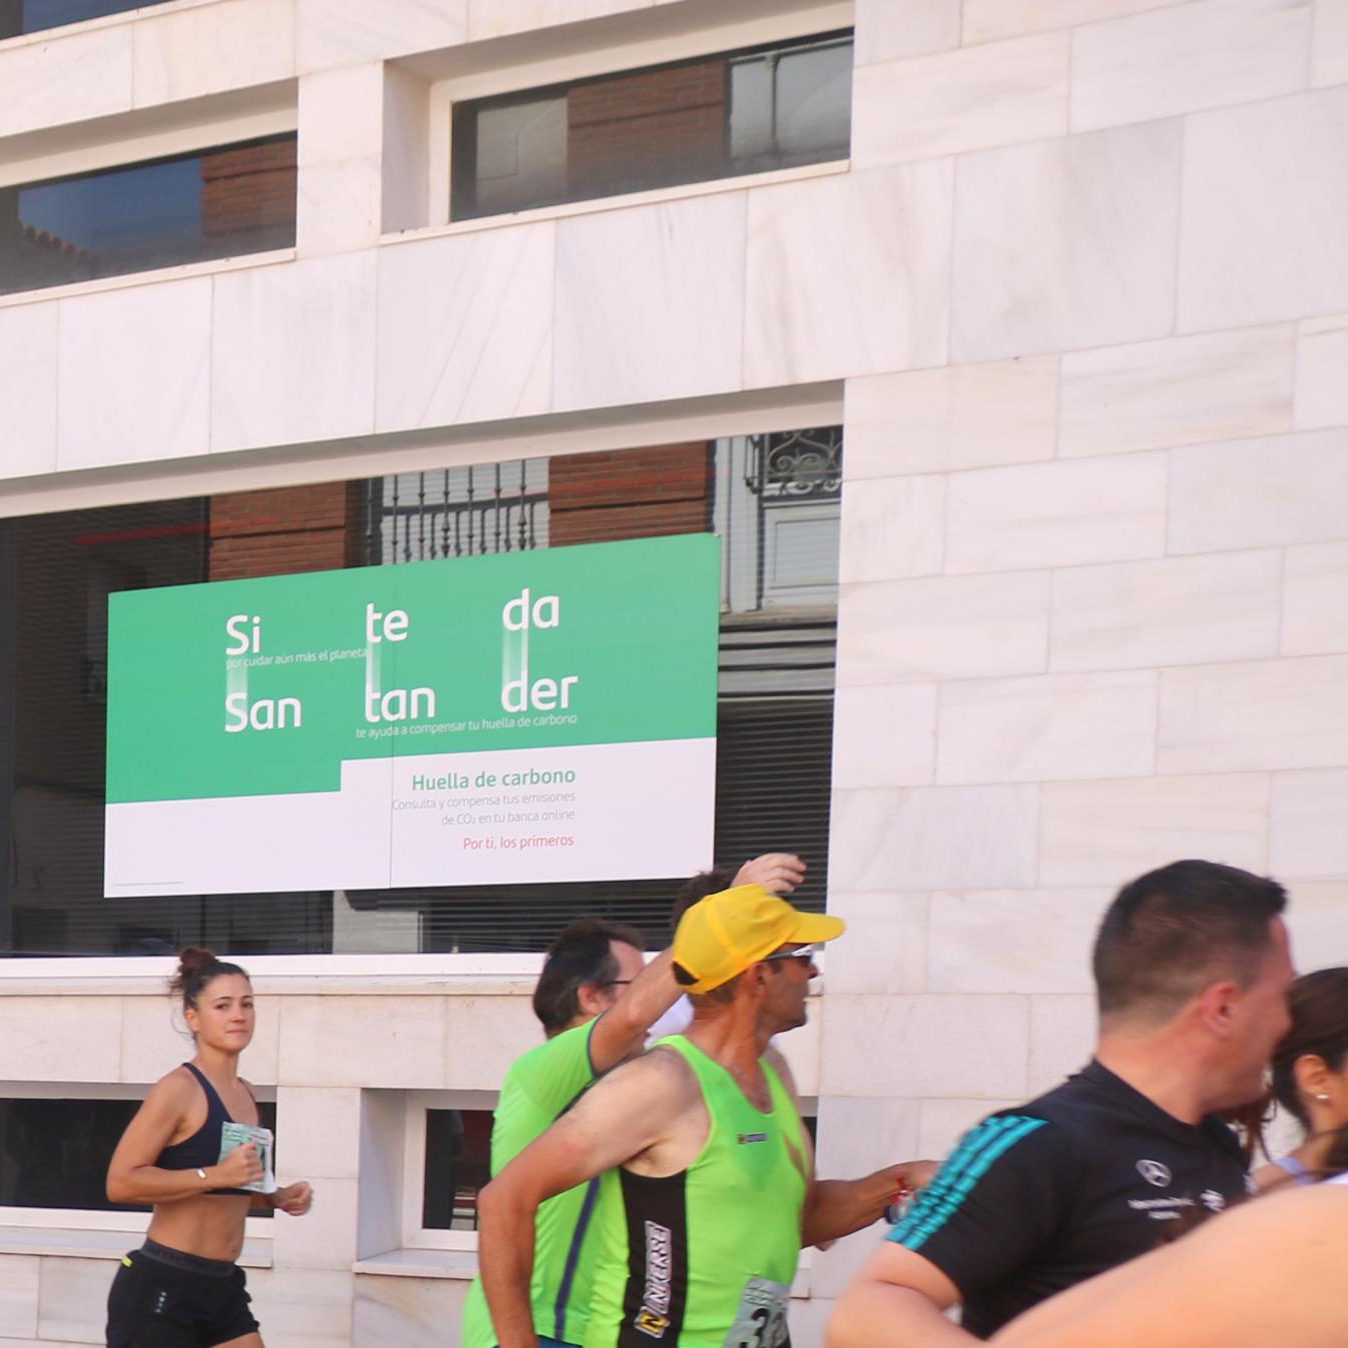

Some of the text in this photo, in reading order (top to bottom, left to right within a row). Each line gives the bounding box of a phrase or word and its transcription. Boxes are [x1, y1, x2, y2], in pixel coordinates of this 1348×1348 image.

[225, 588, 560, 655] Si te da
[244, 656, 272, 667] cuidar
[295, 651, 316, 662] más
[318, 650, 328, 661] el
[330, 648, 368, 661] planeta
[225, 671, 578, 732] San tan der
[356, 728, 366, 738] te
[368, 724, 399, 739] ayuda
[409, 720, 466, 735] compensar
[469, 720, 480, 731] tu
[481, 718, 515, 729] huella
[517, 716, 531, 727] de
[533, 714, 577, 726] carbono
[412, 768, 575, 791] Huella de carbono
[391, 798, 437, 811] Consulta
[439, 799, 446, 811] y
[447, 797, 501, 810] compensa
[441, 814, 455, 826] de
[479, 814, 492, 824] en
[494, 813, 505, 823] tu
[507, 811, 539, 823] banca
[541, 808, 575, 821] online
[463, 837, 482, 850] Por
[500, 836, 517, 849] los
[520, 835, 575, 850] primeros
